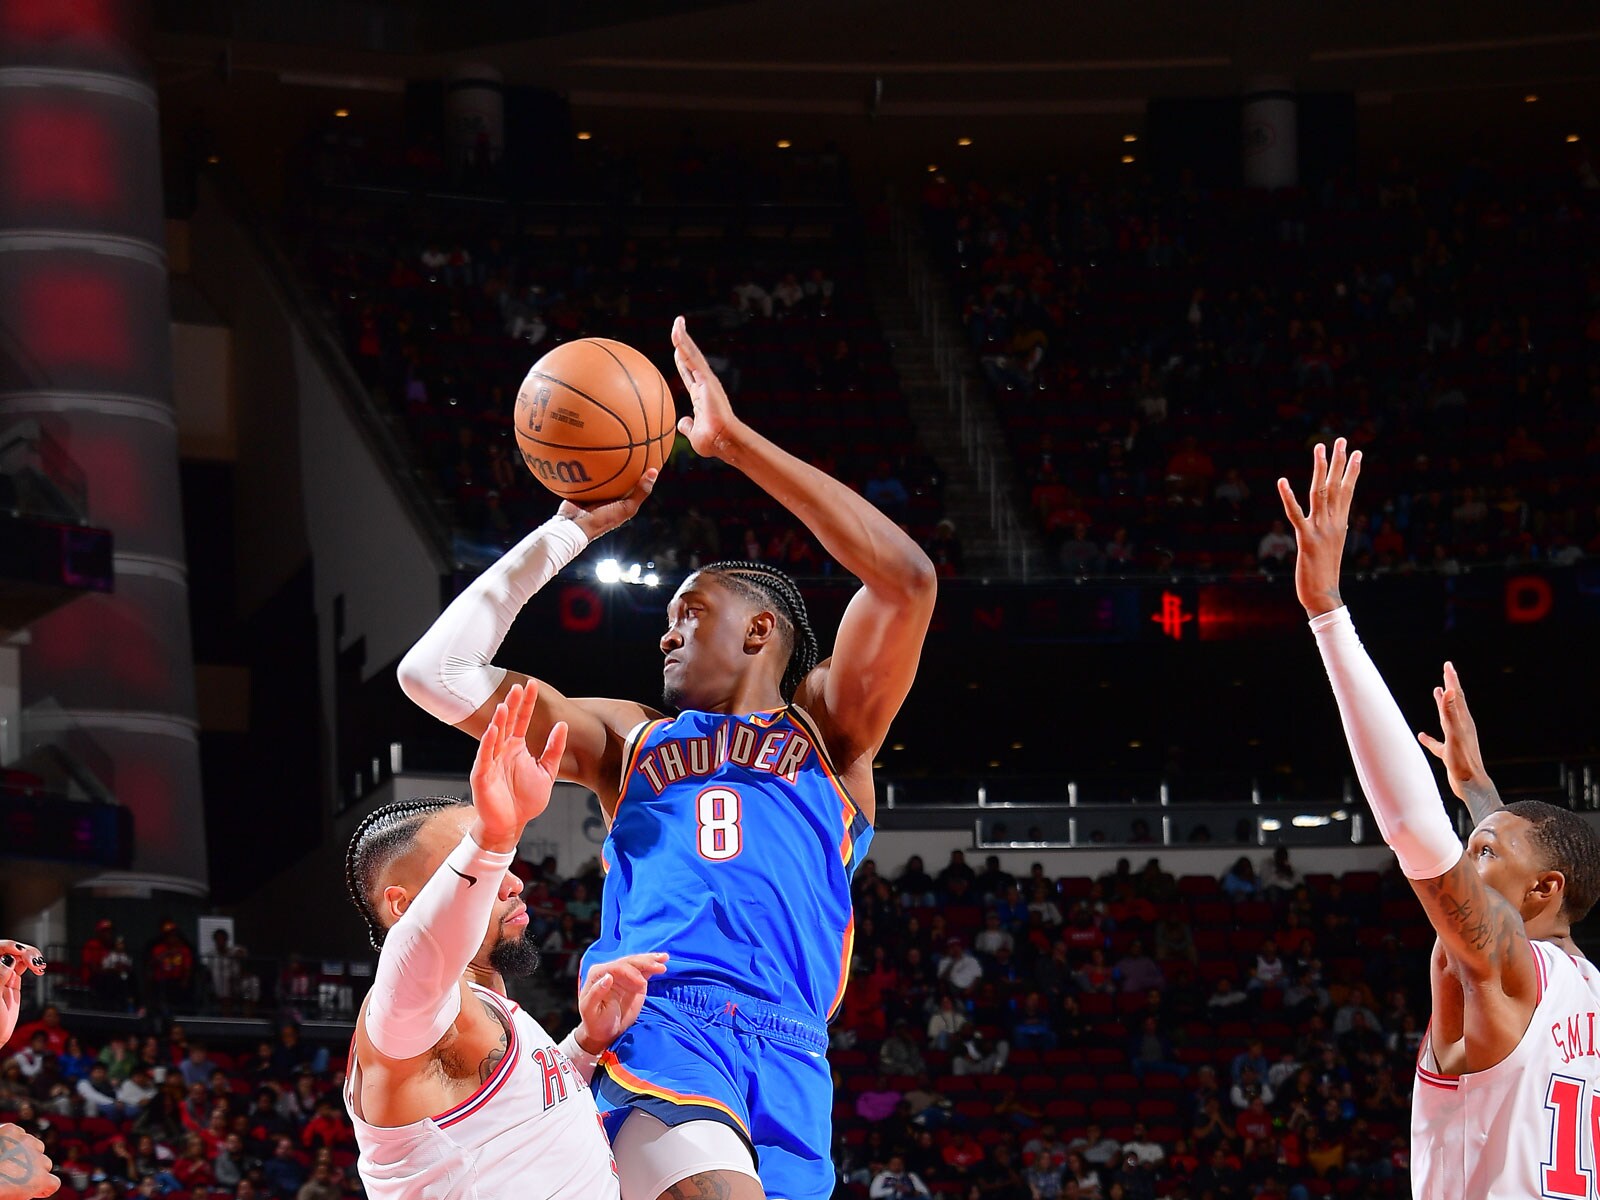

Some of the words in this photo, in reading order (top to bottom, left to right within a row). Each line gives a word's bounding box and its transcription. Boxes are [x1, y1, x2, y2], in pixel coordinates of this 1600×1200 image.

[635, 719, 813, 796] THUNDER
[696, 786, 743, 862] 8
[1551, 1012, 1600, 1064] SMI
